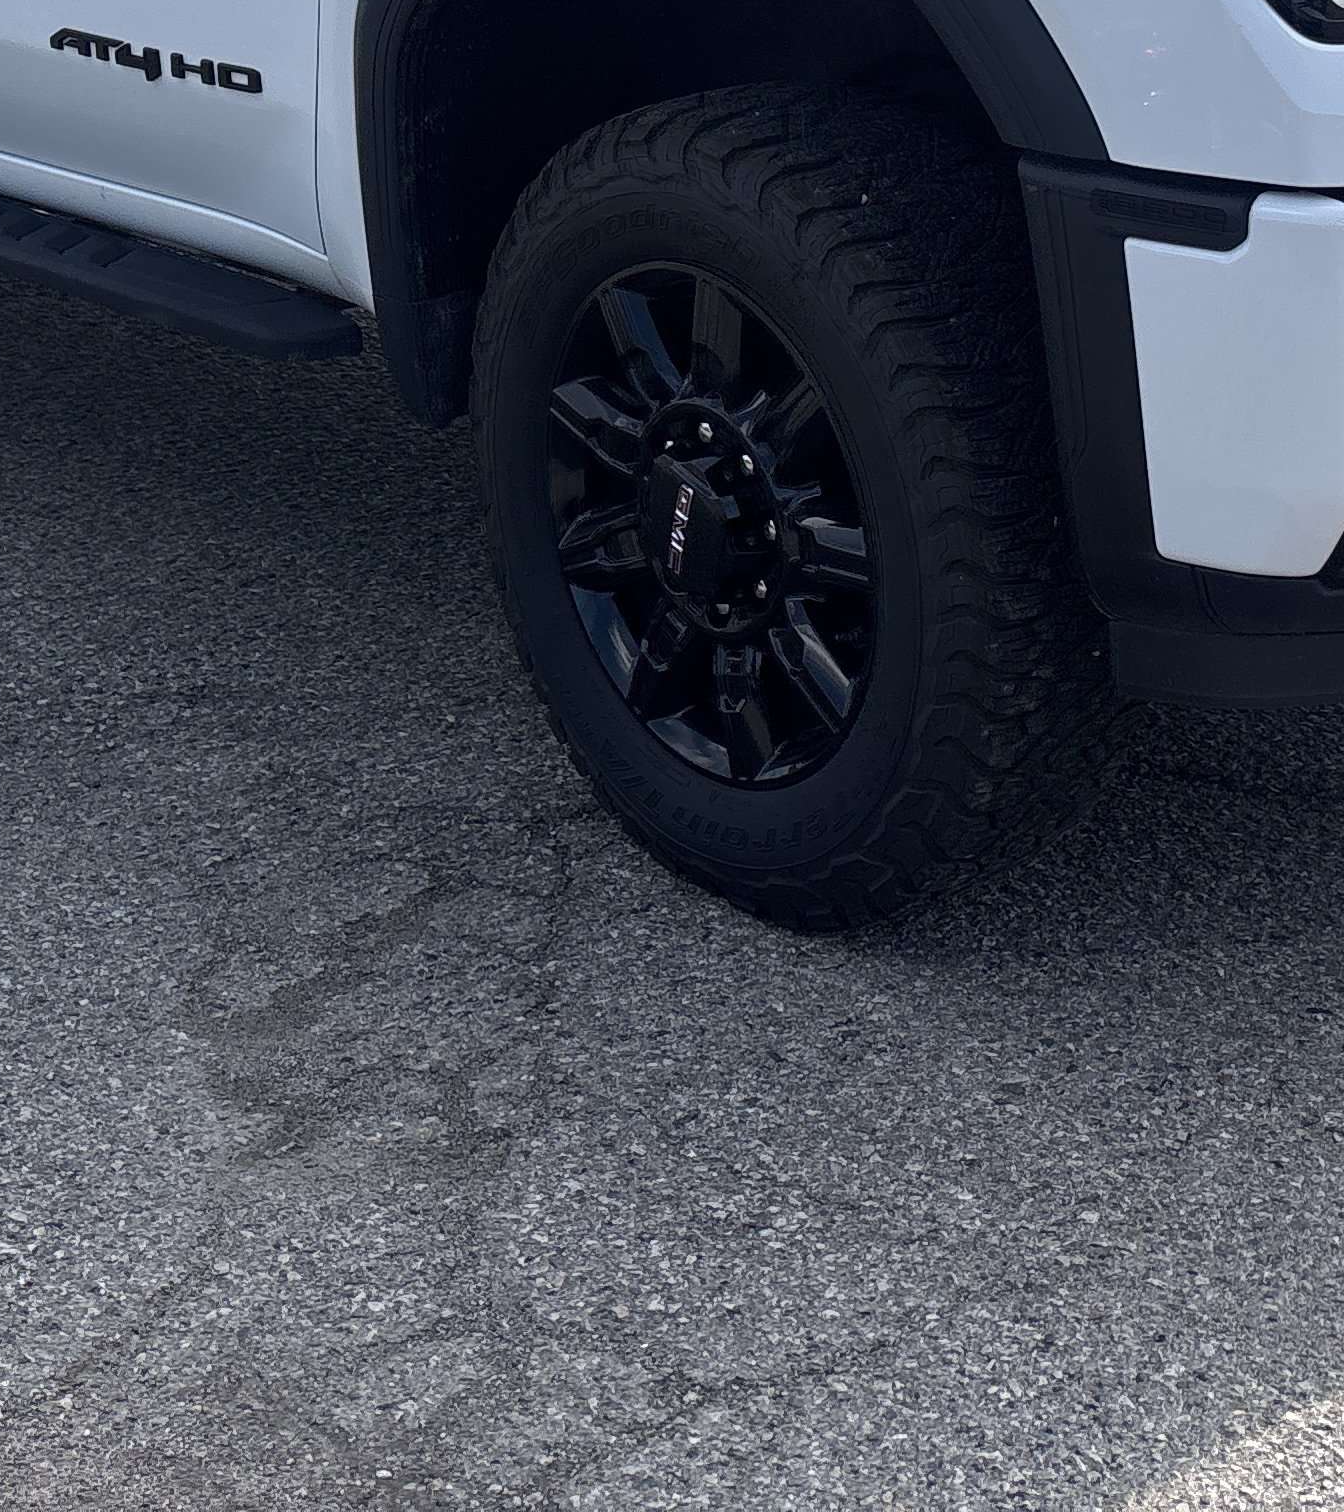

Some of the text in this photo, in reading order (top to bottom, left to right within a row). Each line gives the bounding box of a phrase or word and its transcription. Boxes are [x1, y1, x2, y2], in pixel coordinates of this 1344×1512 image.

[50, 27, 263, 94] AT4 HD
[667, 483, 695, 576] GMC
